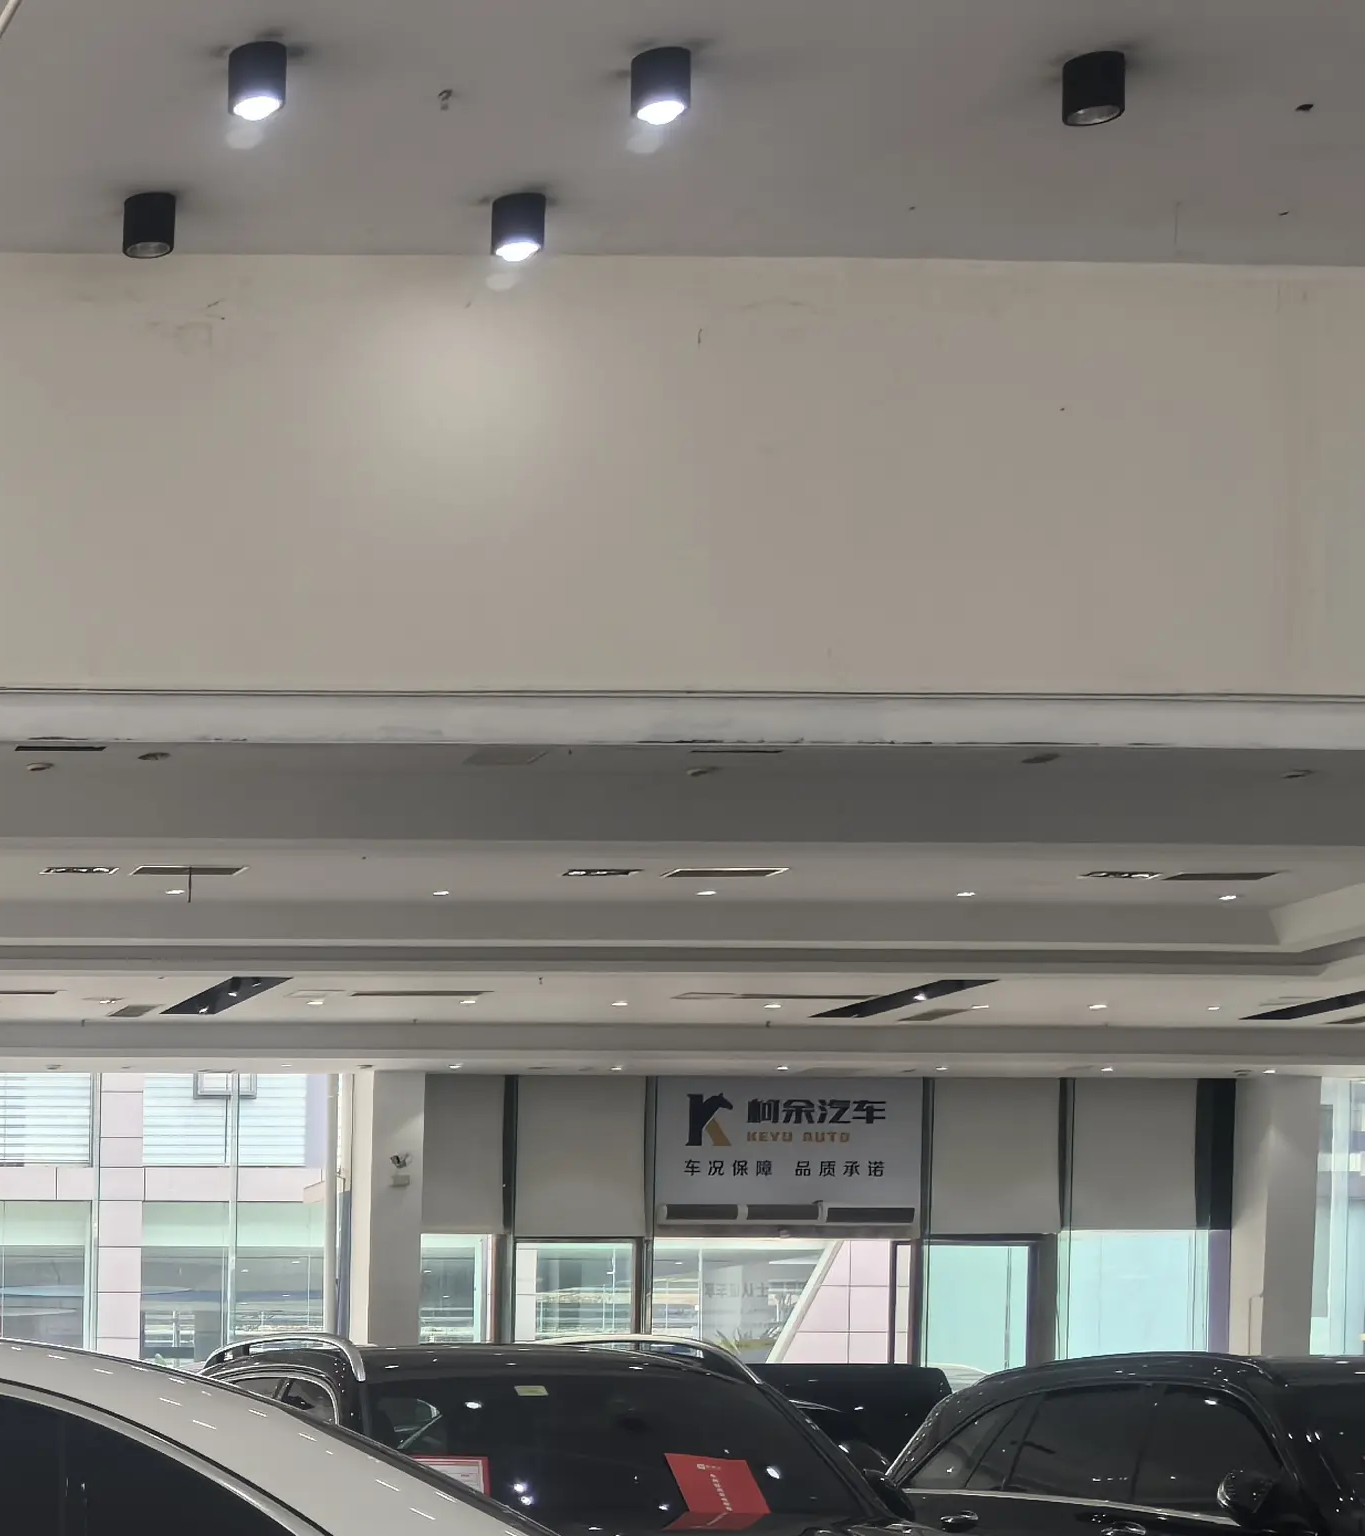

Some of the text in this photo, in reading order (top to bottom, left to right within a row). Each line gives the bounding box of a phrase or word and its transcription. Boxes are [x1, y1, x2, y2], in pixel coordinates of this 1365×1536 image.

[747, 1098, 887, 1124] 柯余汽车
[746, 1131, 851, 1143] KEYU AUTO
[684, 1159, 886, 1178] 车况保障 品质承诺
